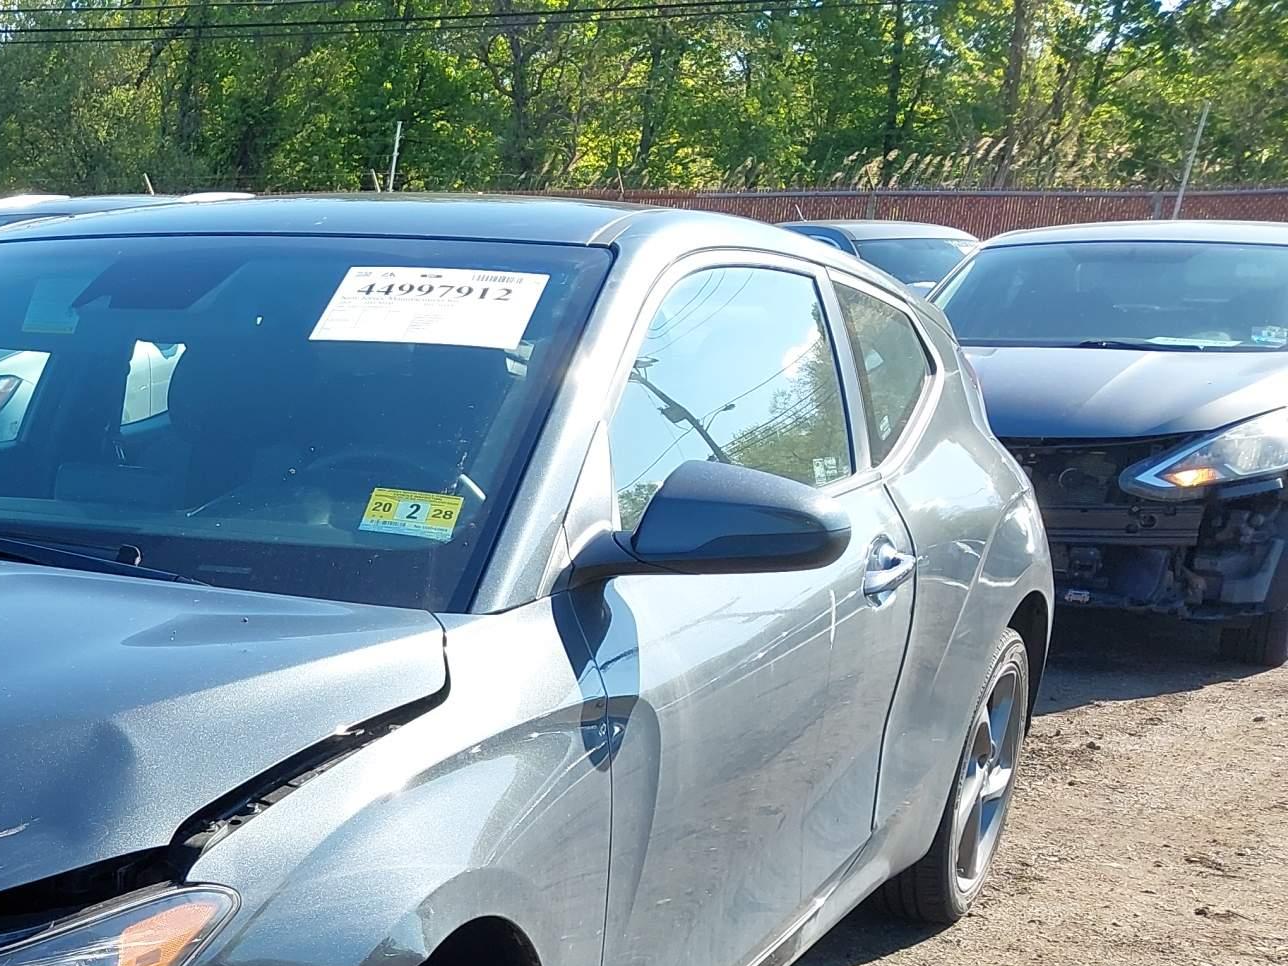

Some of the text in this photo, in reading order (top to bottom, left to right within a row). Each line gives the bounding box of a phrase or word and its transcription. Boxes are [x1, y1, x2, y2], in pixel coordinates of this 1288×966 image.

[357, 282, 513, 301] 44997912
[372, 501, 454, 520] 20 2 28
